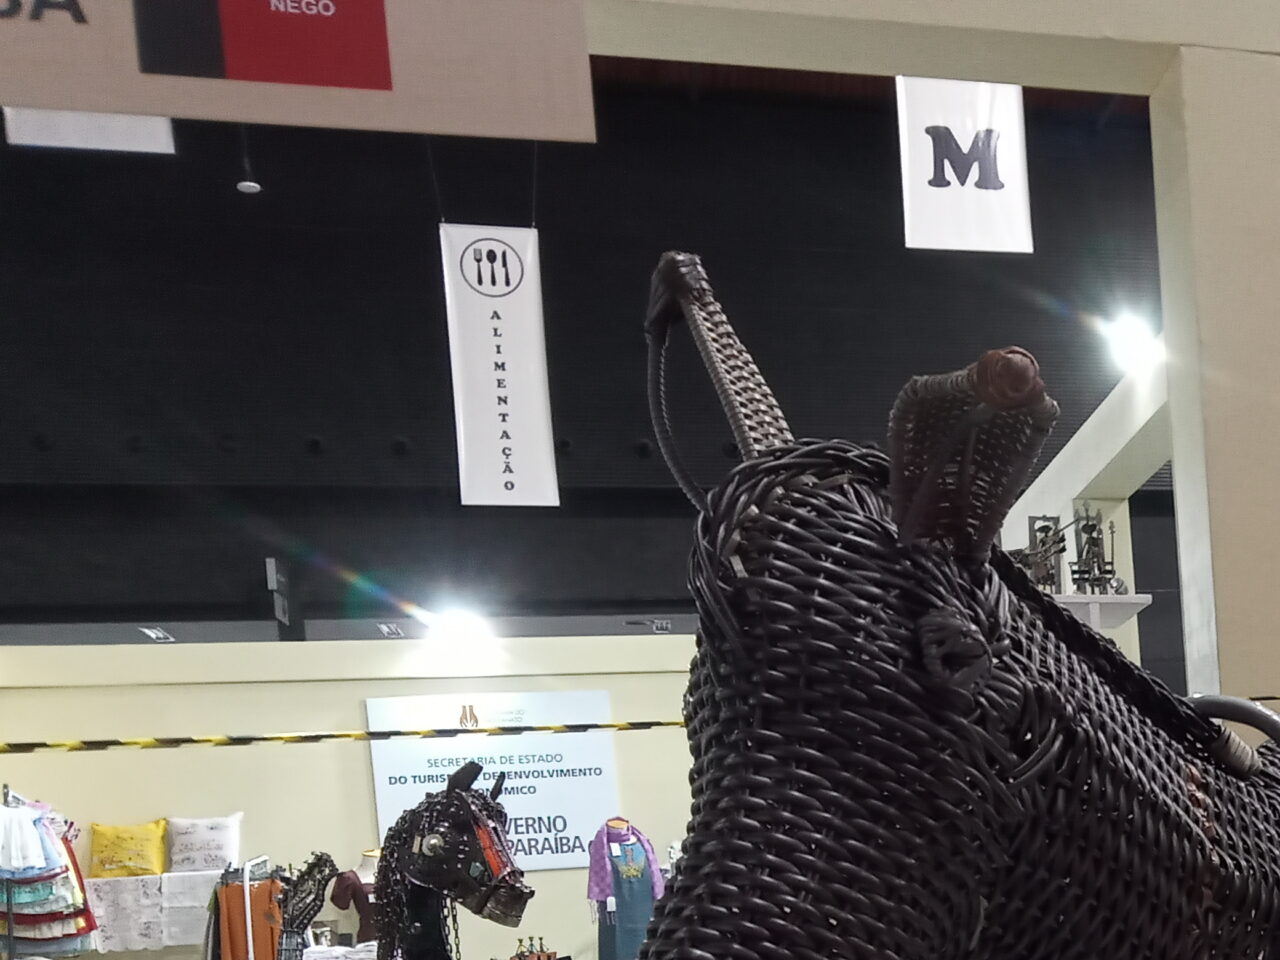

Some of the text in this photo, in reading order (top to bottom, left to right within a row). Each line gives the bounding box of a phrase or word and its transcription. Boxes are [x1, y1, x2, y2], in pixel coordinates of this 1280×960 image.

[269, 0, 337, 17] NEGO
[924, 125, 1005, 190] M
[489, 310, 516, 492] ALIMENTAÇÃO
[499, 755, 515, 767] DE
[518, 753, 564, 765] ESTADO
[388, 767, 603, 786] DO TURIS DEENVOLVIMENTO
[503, 815, 568, 836] VERNO
